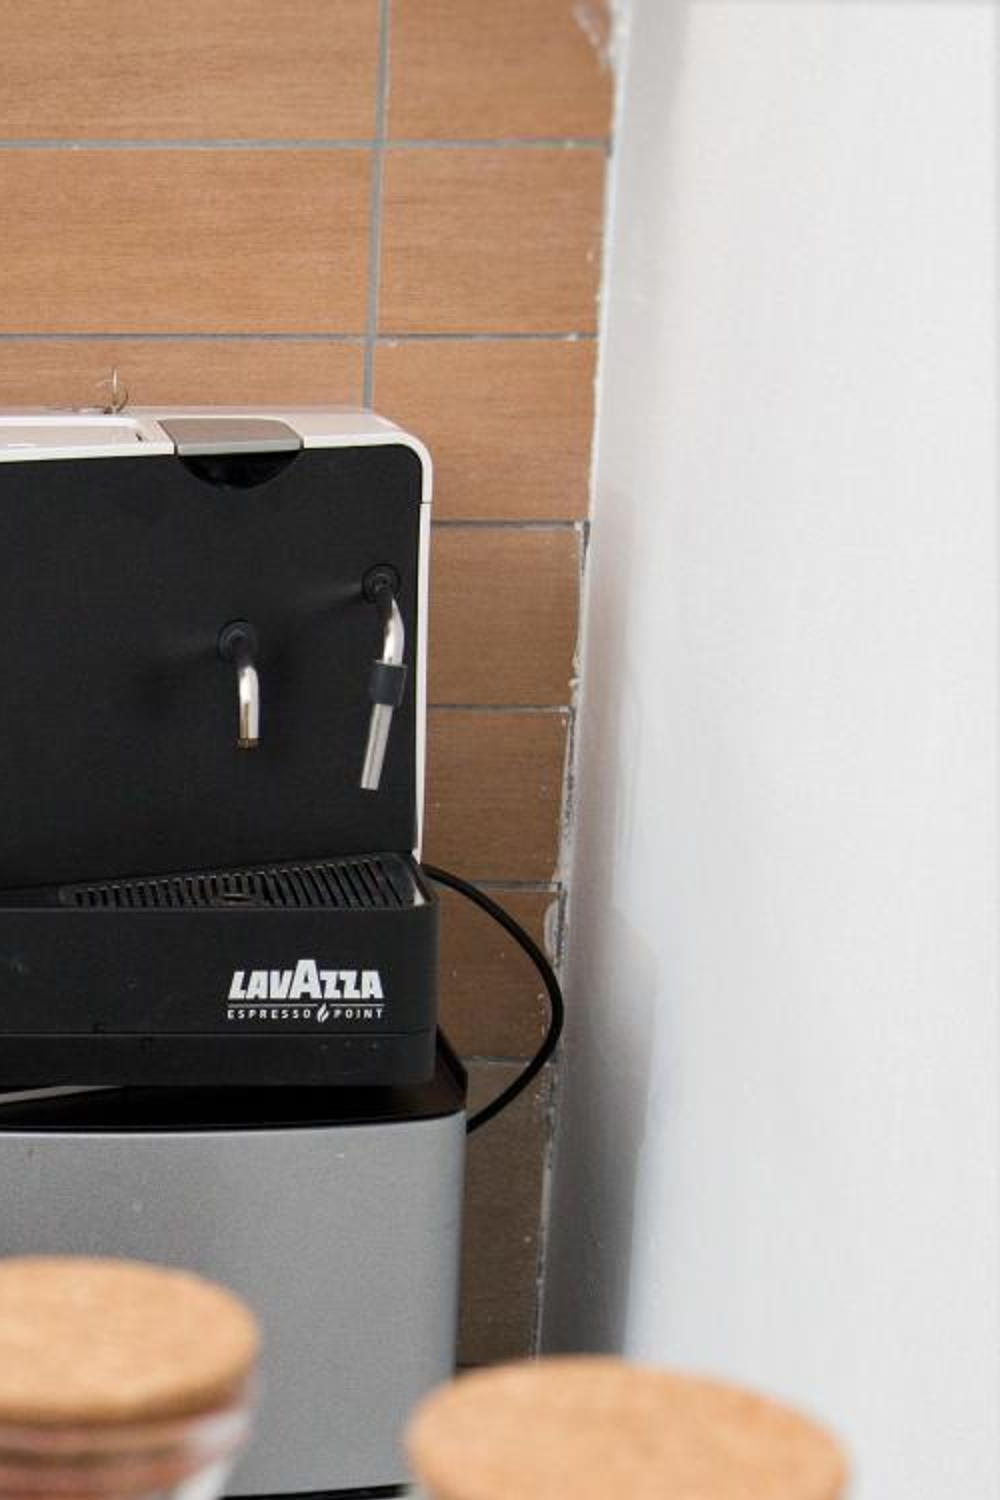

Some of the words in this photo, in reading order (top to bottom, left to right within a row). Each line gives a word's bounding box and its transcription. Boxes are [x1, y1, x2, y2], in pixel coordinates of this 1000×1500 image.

[228, 959, 384, 1000] LAVAZZA
[227, 1008, 311, 1020] ESPRESSO
[333, 1008, 383, 1019] POINT
